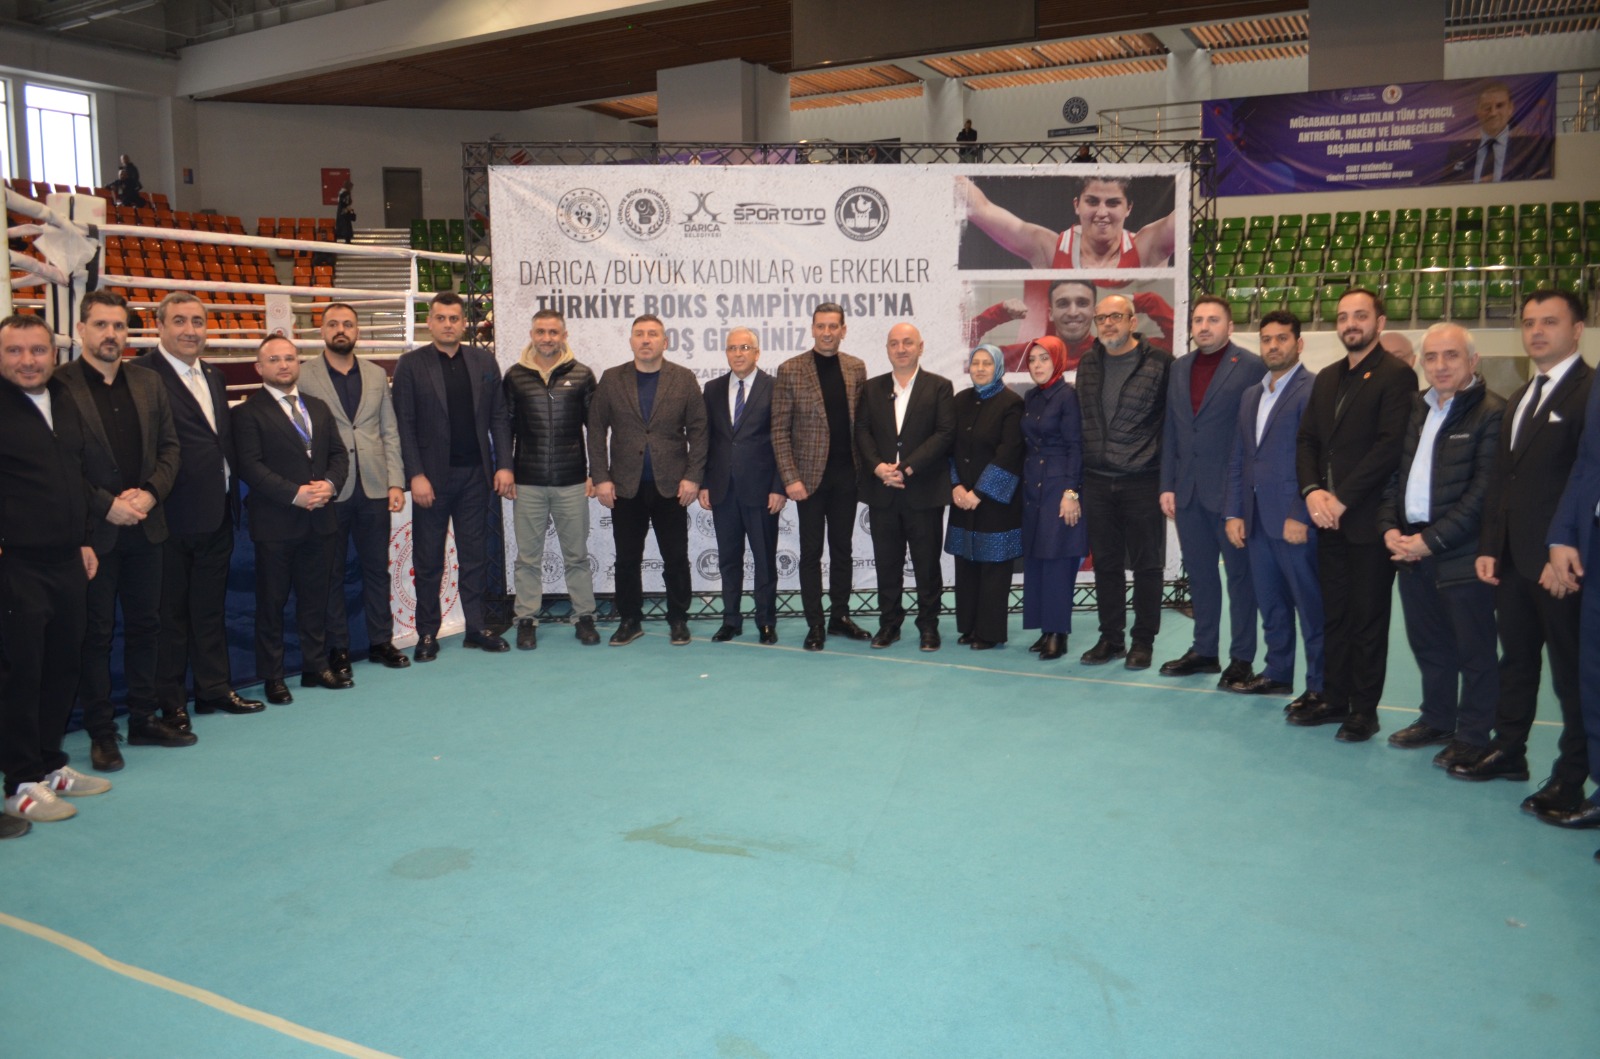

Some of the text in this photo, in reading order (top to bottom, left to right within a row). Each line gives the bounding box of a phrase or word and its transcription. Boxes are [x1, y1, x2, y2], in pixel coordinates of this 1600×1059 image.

[1289, 106, 1455, 129] MÜSABAKALARA KATILAN TÜM SPORCU,
[1298, 127, 1344, 143] ANTRENÖR,
[1345, 127, 1376, 140] HAKEM
[1378, 126, 1389, 138] VE
[1326, 141, 1373, 158] BAŞARILAR
[626, 187, 643, 199] BOKS
[643, 187, 671, 225] FEDERASYONU
[684, 224, 721, 232] DARICA
[519, 259, 597, 286] DARICA
[692, 258, 795, 285] KADINLAR
[801, 264, 823, 284] ve
[830, 257, 930, 284] ERKEKLER
[535, 288, 636, 319] TÜRKİYE
[644, 293, 708, 318] BOKS
[665, 327, 695, 359] OŞ
[640, 562, 664, 570] SPOR
